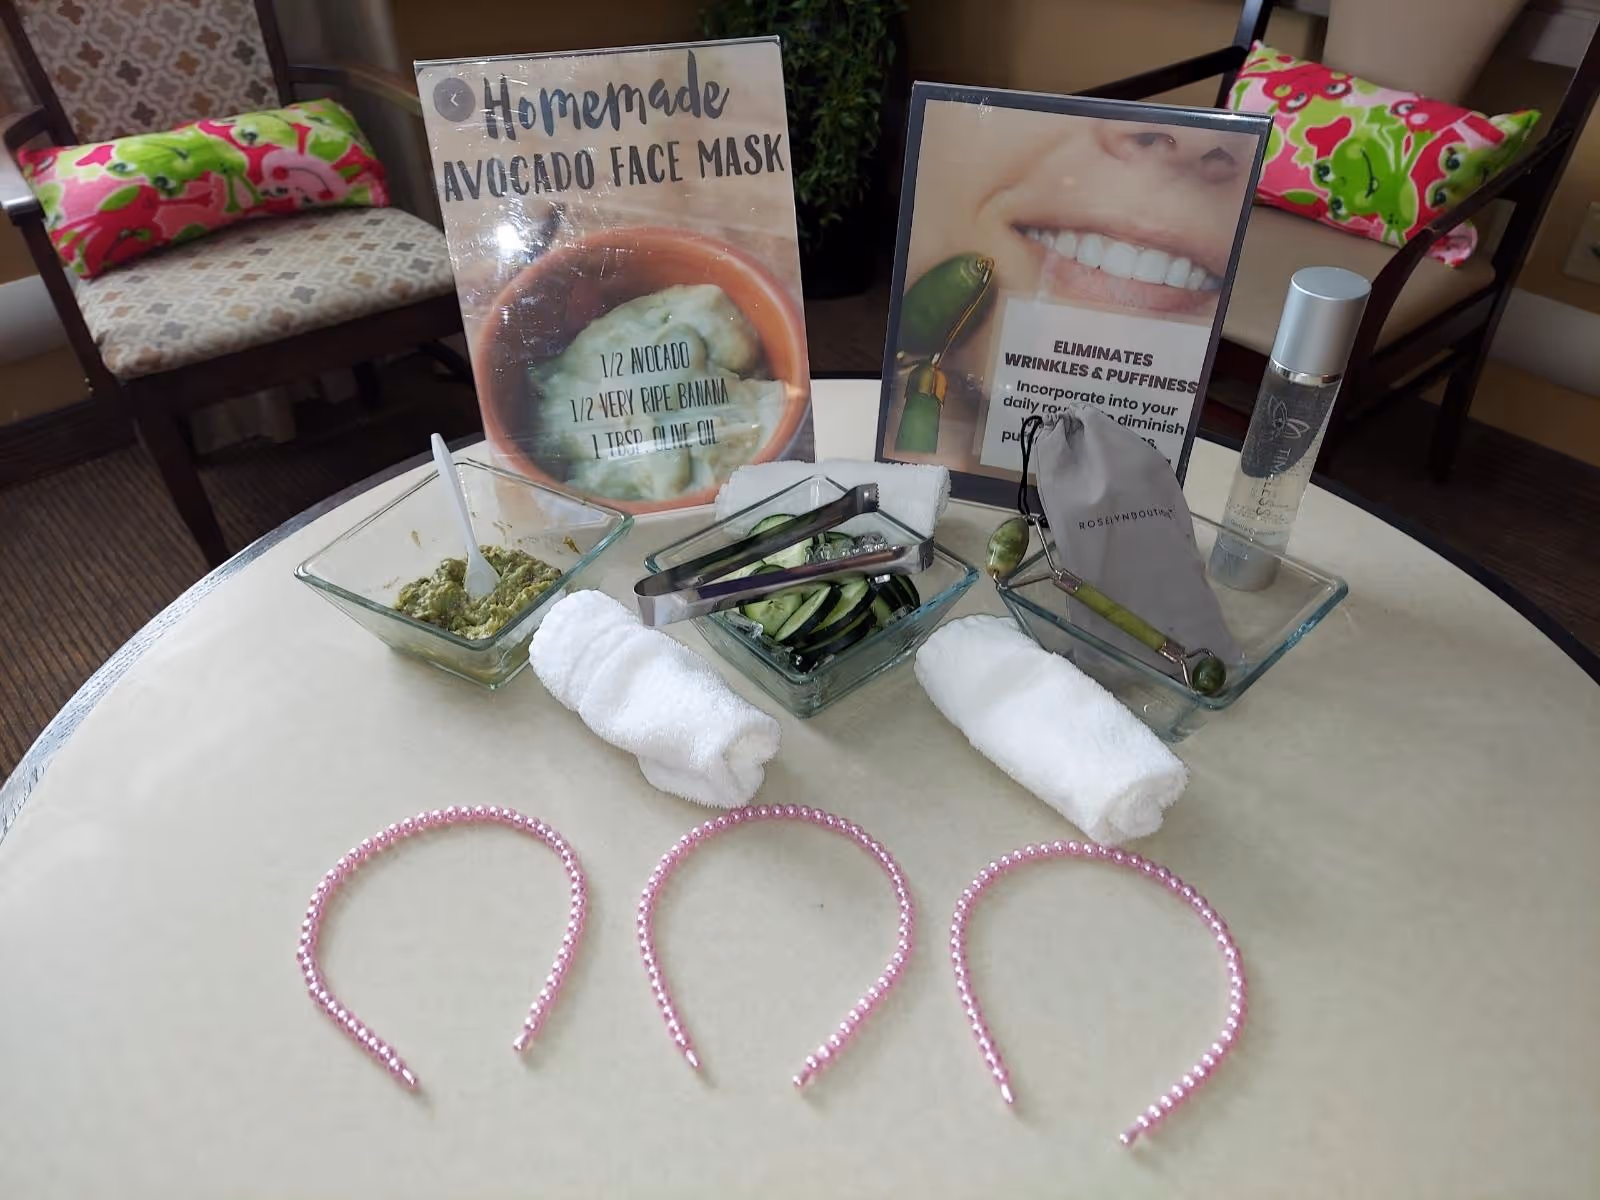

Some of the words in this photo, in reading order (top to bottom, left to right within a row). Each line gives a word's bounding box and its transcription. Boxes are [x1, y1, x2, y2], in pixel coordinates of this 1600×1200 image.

[483, 49, 729, 141] Homemade
[443, 149, 595, 202] AVOCADO
[609, 140, 683, 187] FACE
[698, 132, 785, 178] MASK
[600, 352, 624, 378] 1/2
[630, 341, 690, 374] AVOCADO
[1004, 352, 1089, 377] WRINKLES
[1091, 366, 1103, 380] &
[1105, 368, 1199, 394] PUFFINESS
[1053, 339, 1154, 367] ELIMINATES
[571, 397, 595, 422] 1/2
[599, 389, 635, 418] VERY
[640, 383, 674, 413] RIPE
[678, 379, 728, 409] BANANA
[1003, 395, 1040, 414] daily
[1117, 416, 1186, 435] diminish
[1016, 380, 1106, 405] Incorporate
[1108, 394, 1139, 411] into
[1141, 402, 1179, 417] your
[592, 434, 600, 460] 1
[653, 422, 692, 451] OLIVE
[697, 419, 719, 445] OIL
